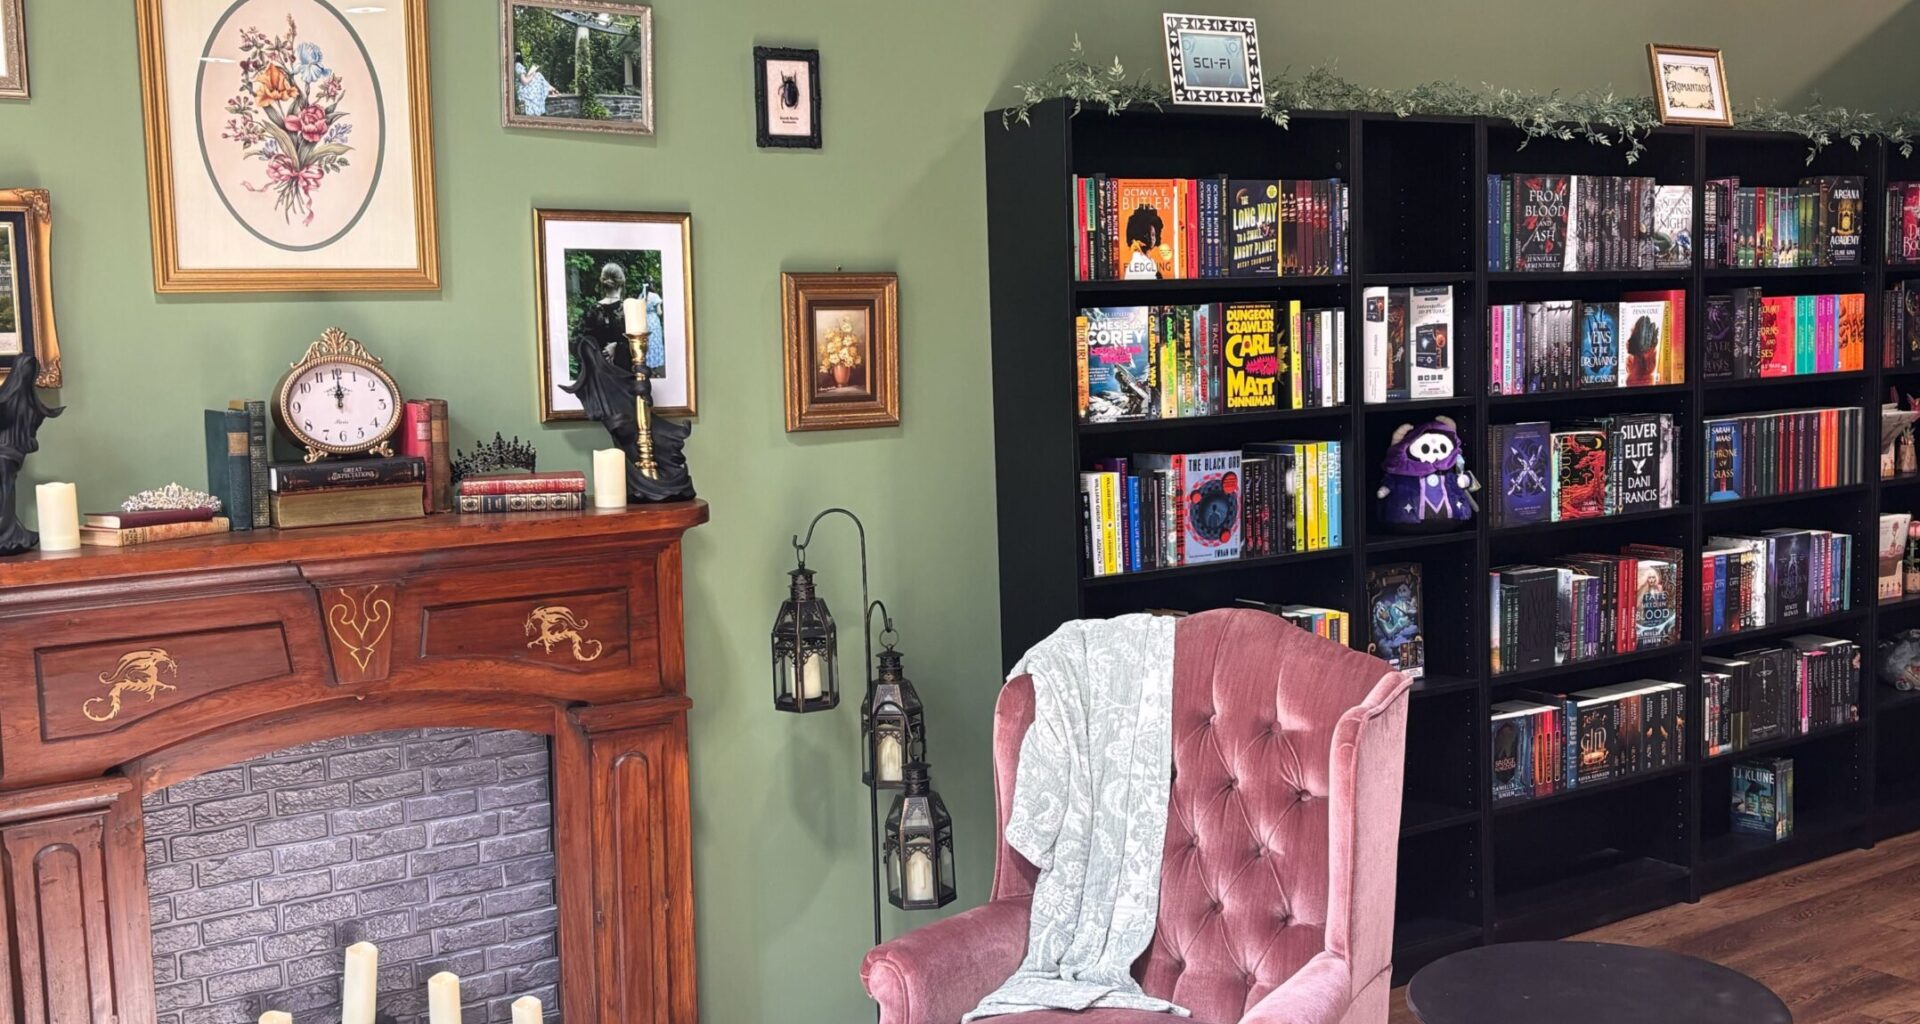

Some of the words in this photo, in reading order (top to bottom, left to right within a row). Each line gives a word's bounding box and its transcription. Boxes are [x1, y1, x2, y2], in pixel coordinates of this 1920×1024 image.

[1193, 57, 1231, 70] SCI-FI
[1124, 189, 1158, 197] OCTAVIA
[1161, 189, 1168, 197] E.
[1529, 190, 1563, 202] FROM
[1122, 197, 1170, 210] BUTLER
[1241, 196, 1249, 206] THE
[1233, 207, 1256, 231] LONG
[1257, 202, 1278, 224] WAY
[1525, 205, 1566, 217] BLOOD
[1237, 233, 1243, 244] TO
[1243, 233, 1247, 243] A
[1247, 228, 1263, 241] SMALL
[1533, 231, 1555, 242] ASH
[1830, 235, 1860, 248] ACADEMY
[1234, 243, 1254, 260] ANGRY
[1254, 239, 1277, 256] PLANET
[1124, 262, 1172, 273] FLEDGLING
[1237, 261, 1250, 269] BECKY
[1251, 256, 1272, 266] CHAMBERS
[1227, 309, 1274, 322] DUNGEON
[1088, 321, 1121, 331] JAMES
[1184, 316, 1192, 348] JAMES
[1226, 321, 1274, 334] CRAWLER
[1088, 329, 1146, 346] COREY
[1225, 333, 1276, 368] CARL
[1581, 356, 1617, 368] DROWNING
[315, 372, 324, 384] 11
[331, 368, 343, 380] 12
[352, 371, 357, 383] 1
[1227, 367, 1275, 397] MATT
[300, 382, 312, 395] 10
[367, 379, 376, 392] 2
[292, 401, 302, 414] 9
[379, 398, 387, 411] 3
[1228, 395, 1275, 408] DINNIMAN
[304, 420, 314, 432] 8
[370, 417, 381, 429] 4
[1712, 427, 1731, 435] SARAH
[322, 429, 330, 441] 7
[339, 431, 348, 442] 6
[357, 427, 365, 439] 5
[1621, 423, 1658, 440] SILVER
[1625, 442, 1654, 459] ELITE
[1710, 448, 1738, 459] THRONE
[1188, 459, 1201, 472] THE
[1205, 457, 1226, 471] BLACK
[1229, 456, 1240, 470] ORB
[1712, 469, 1735, 480] GLASS
[1628, 476, 1651, 490] DANI
[1623, 489, 1658, 504] FRANCIS
[1644, 592, 1668, 601] FATE
[1636, 609, 1670, 621] BLOOD
[1732, 767, 1742, 778] TJ
[1744, 770, 1775, 785] KLUNE
